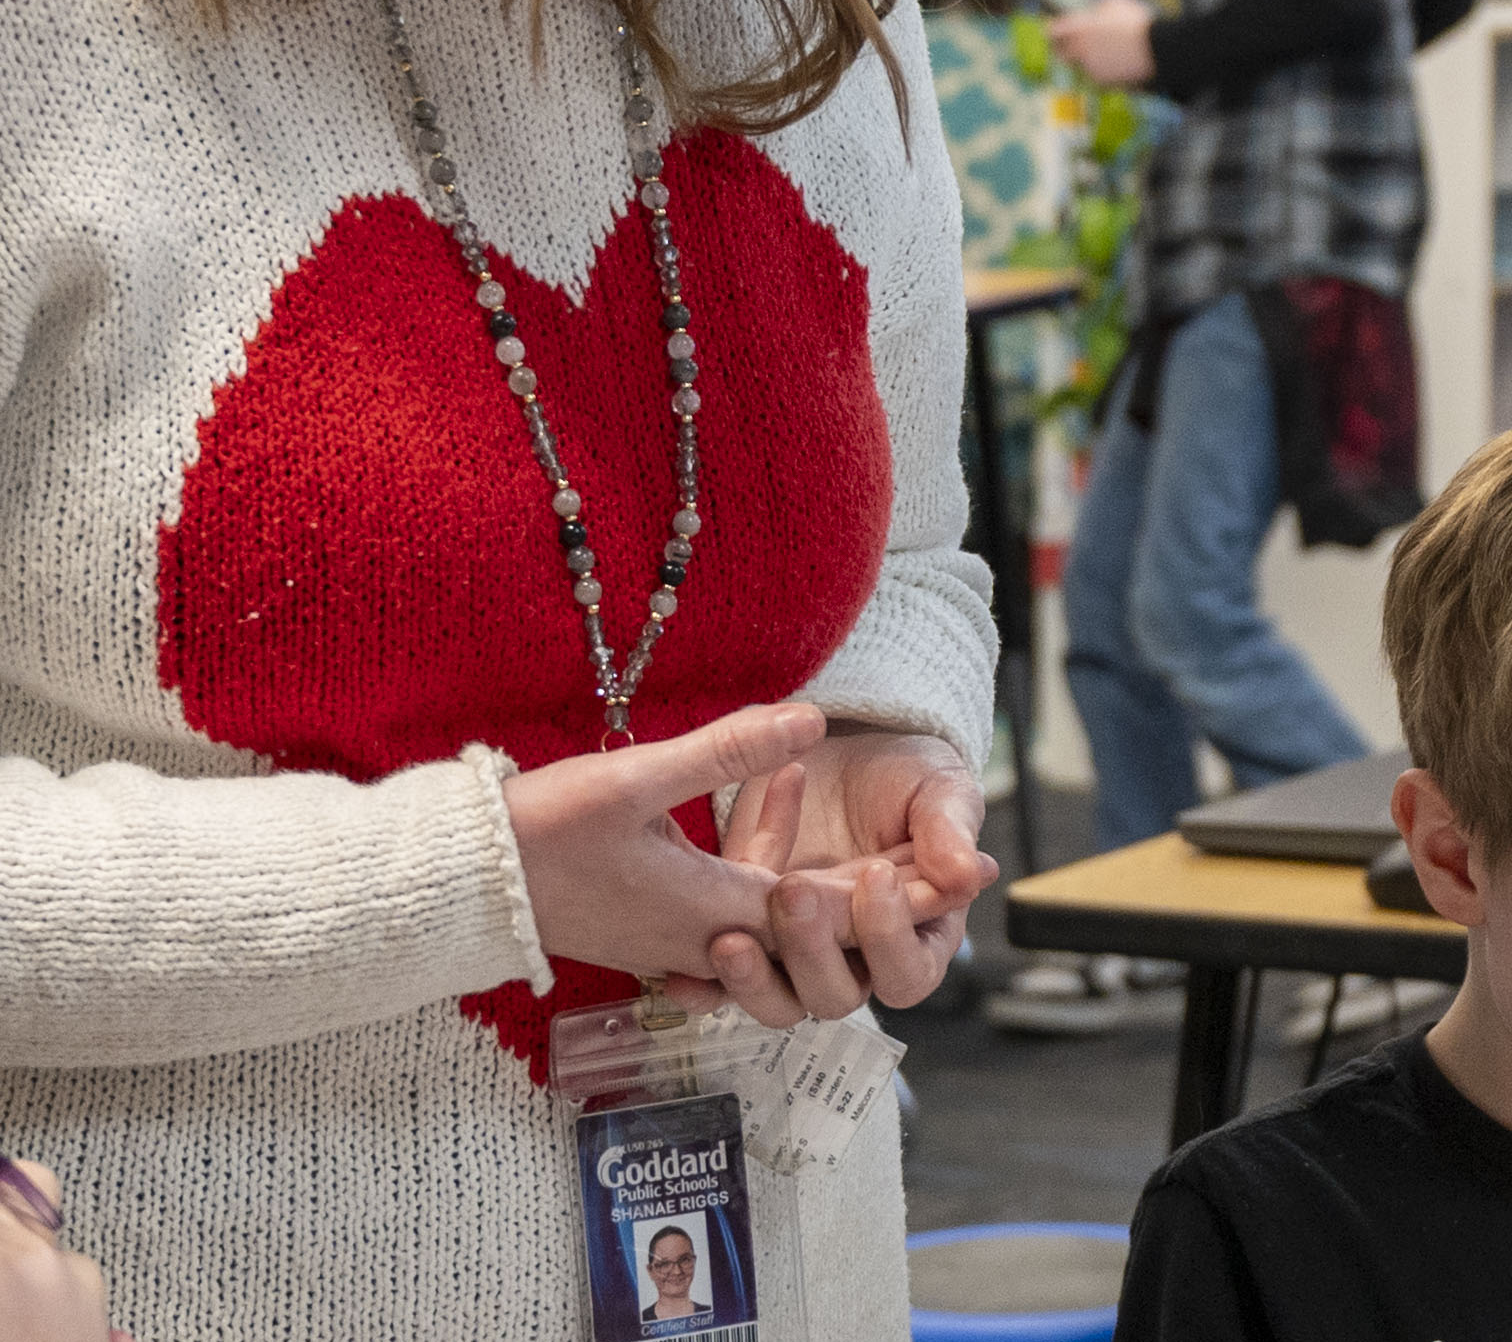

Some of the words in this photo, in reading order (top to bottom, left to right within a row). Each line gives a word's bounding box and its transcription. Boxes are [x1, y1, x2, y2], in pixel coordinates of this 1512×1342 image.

[598, 1140, 728, 1189] Goddard
[618, 1182, 662, 1204] Public
[664, 1174, 719, 1196] Schools
[611, 1201, 677, 1224] SHANAE
[679, 1190, 730, 1214] RIGGS
[640, 1318, 687, 1338] Certified
[689, 1313, 715, 1332] Staff
